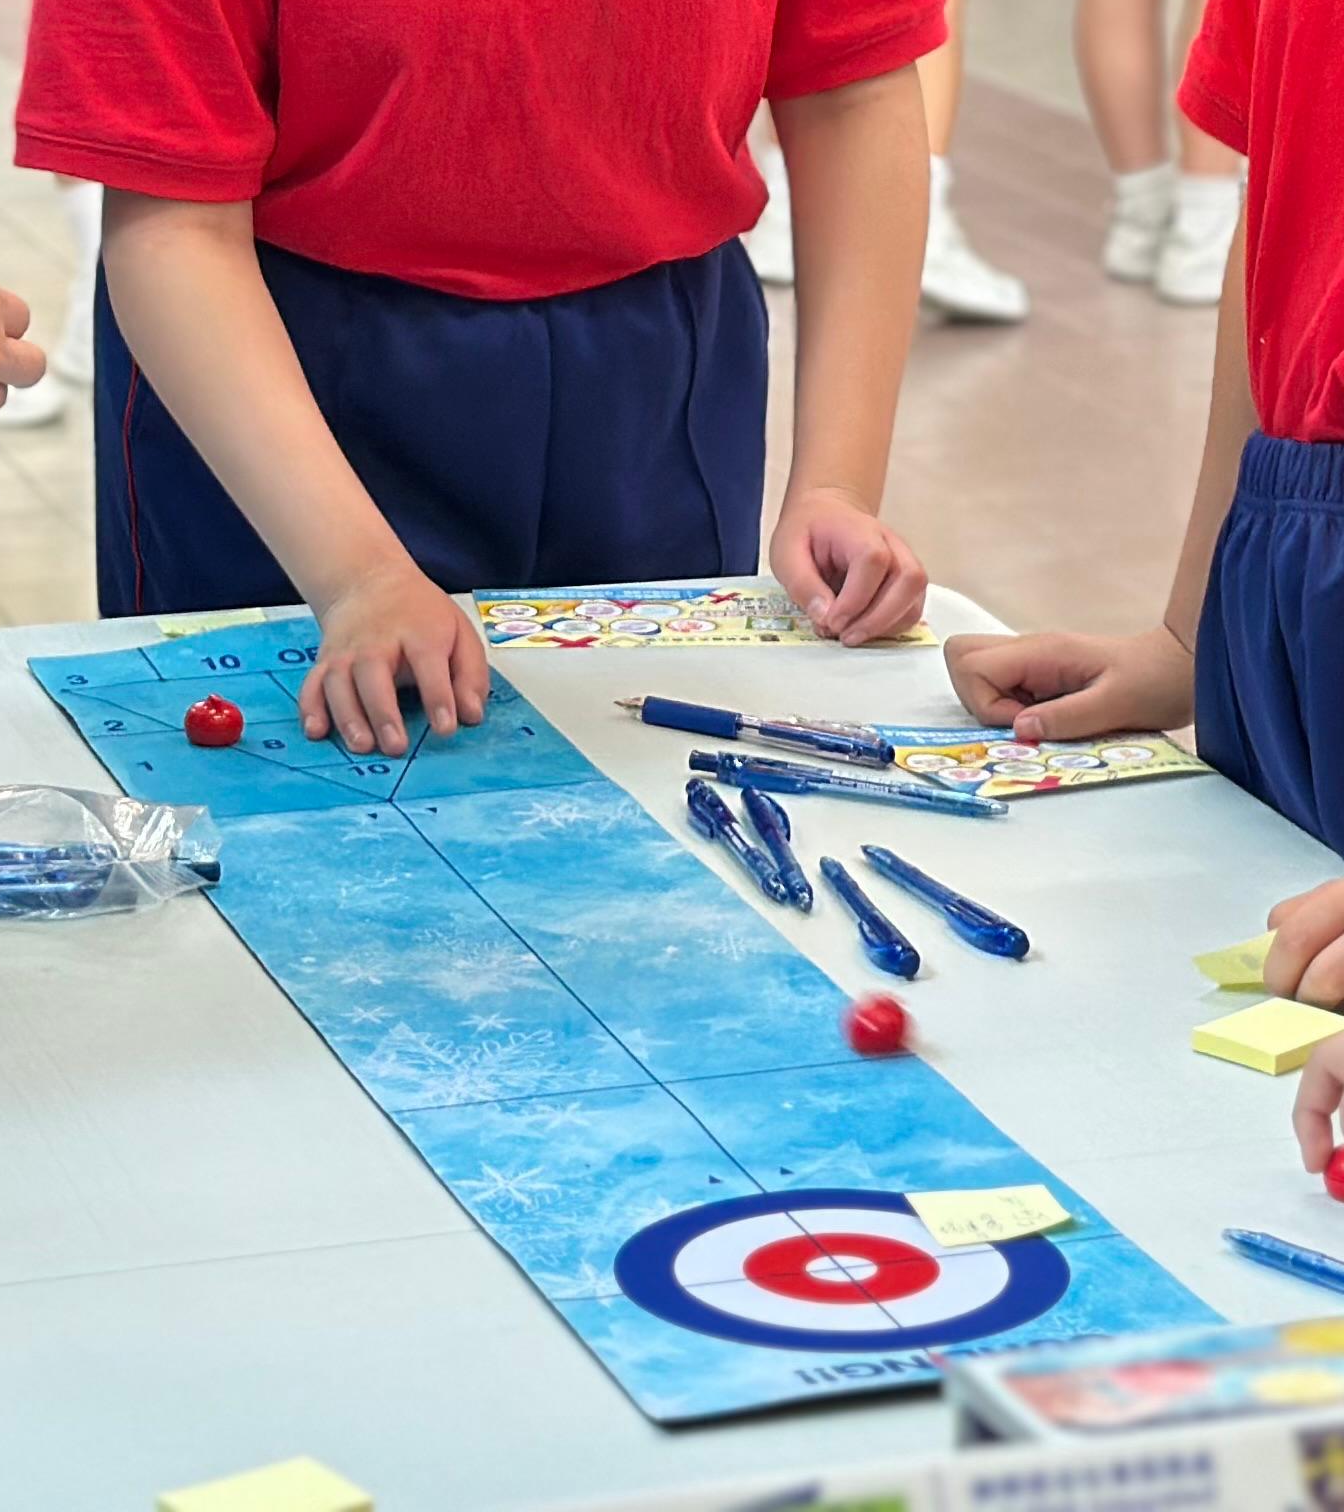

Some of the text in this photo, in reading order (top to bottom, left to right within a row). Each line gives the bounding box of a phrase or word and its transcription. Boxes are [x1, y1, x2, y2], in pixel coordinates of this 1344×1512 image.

[201, 654, 241, 671] 10
[66, 674, 89, 686] 3
[104, 719, 127, 732] 2
[347, 764, 391, 776] 10
